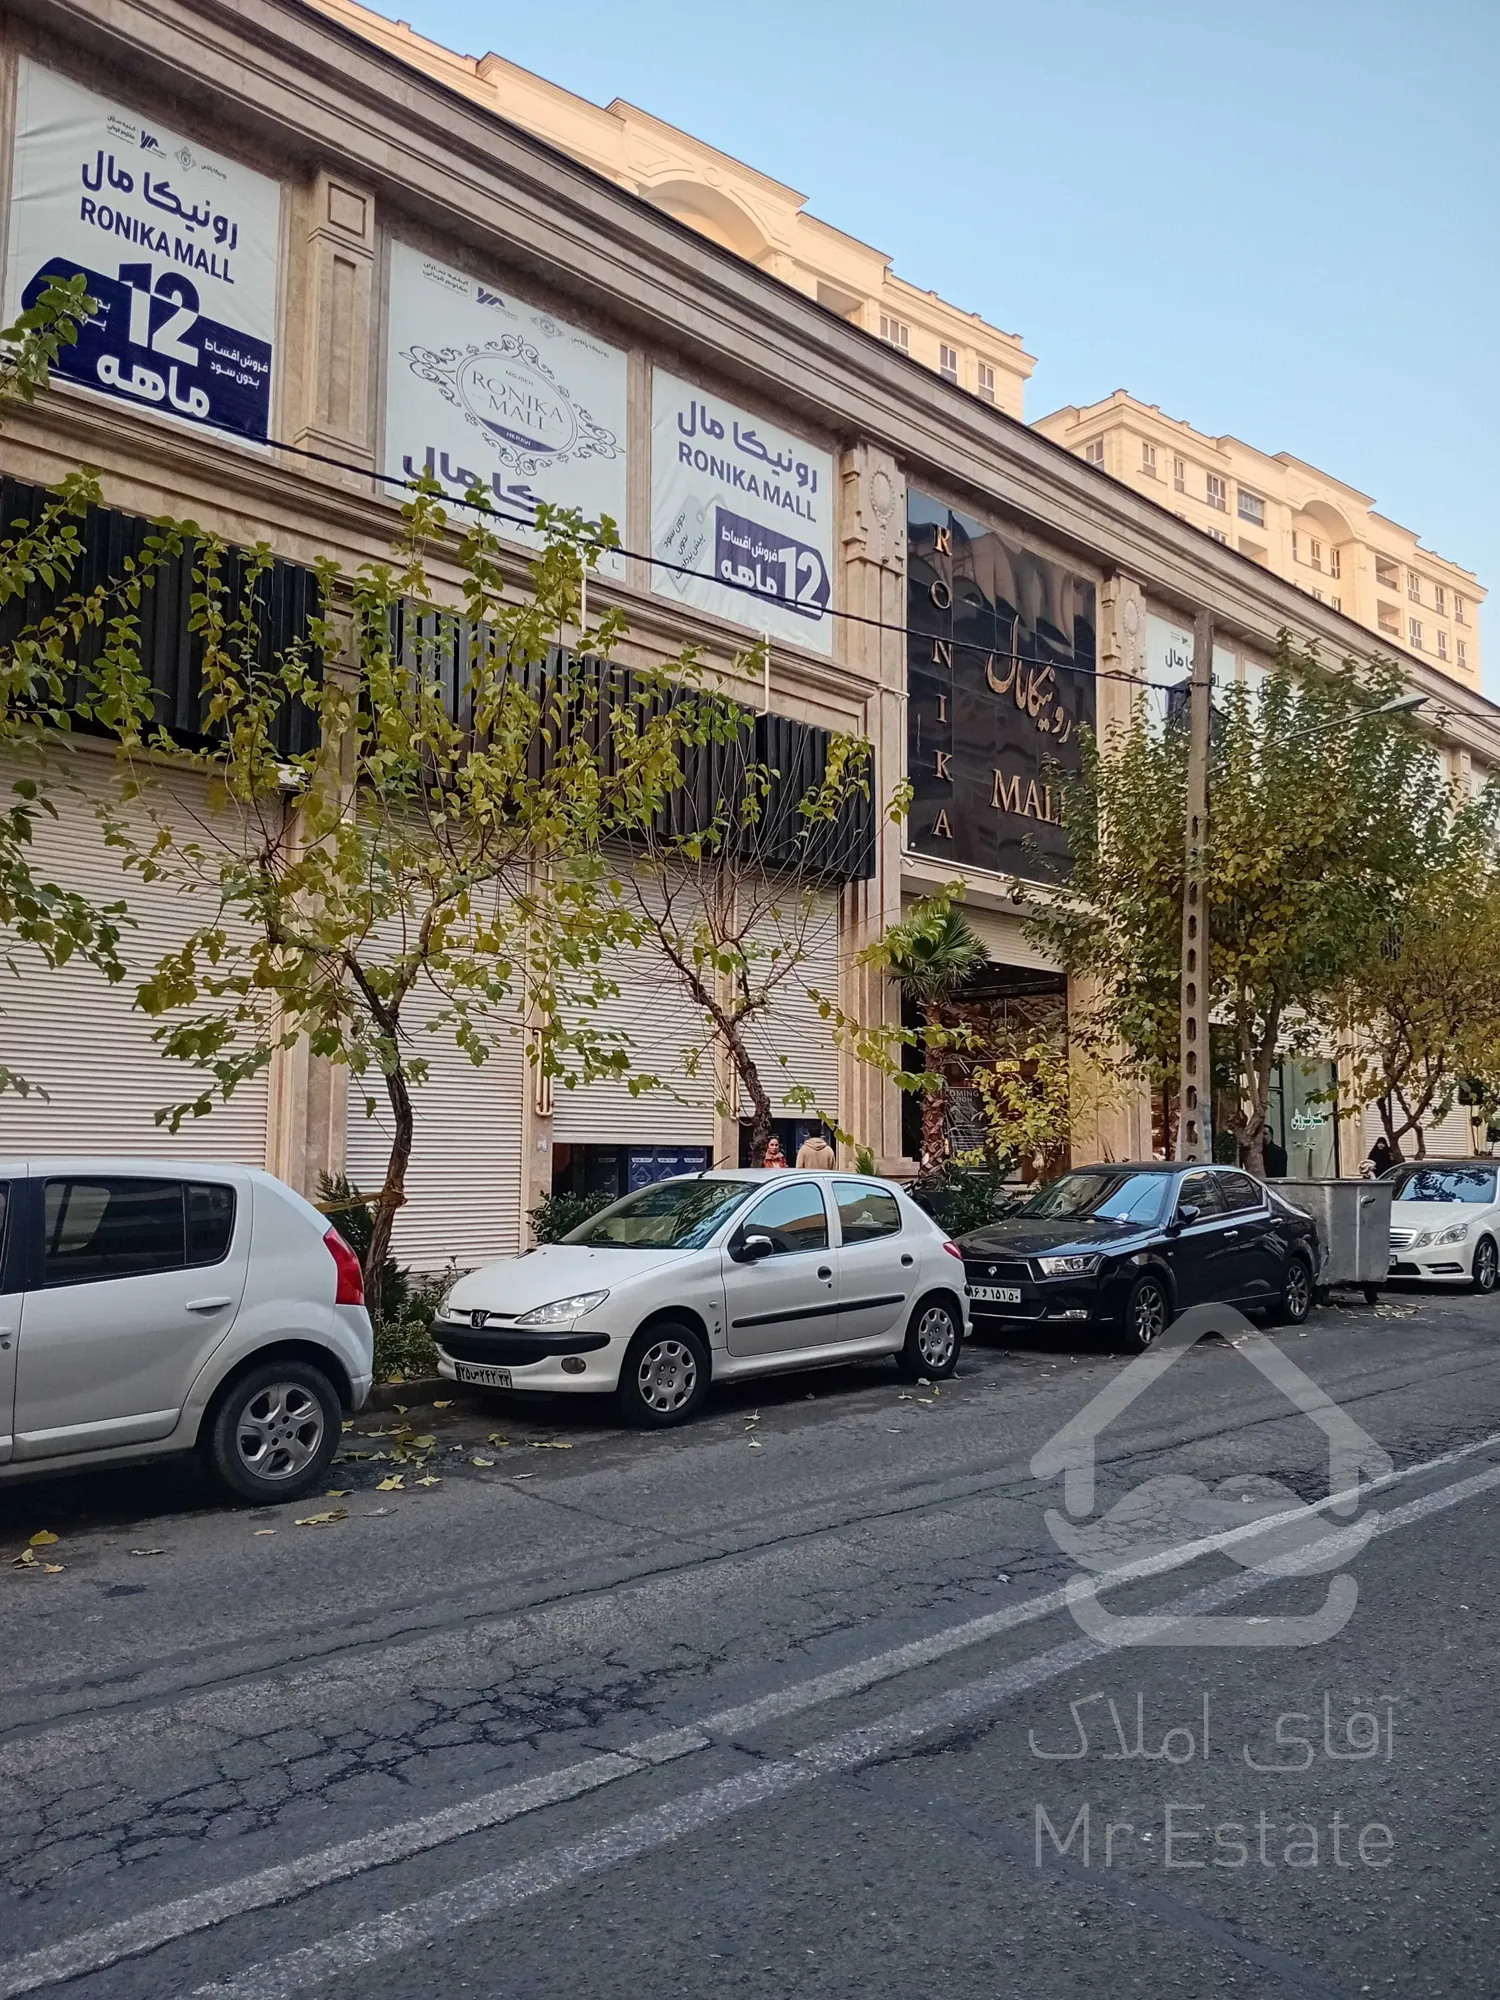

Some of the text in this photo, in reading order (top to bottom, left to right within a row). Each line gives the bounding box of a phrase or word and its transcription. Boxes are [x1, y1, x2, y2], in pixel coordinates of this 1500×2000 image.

[82, 150, 238, 251] رونیکا مال
[81, 196, 235, 284] RONIKA MALL
[118, 262, 200, 366] 12
[205, 338, 269, 373] فروش اقساط
[211, 361, 260, 389] بدون سود
[505, 369, 534, 387] MOJDEH
[96, 353, 210, 418] ماهه
[472, 370, 563, 423] RONIKA
[489, 394, 550, 433] MALL
[402, 446, 483, 490] مال
[678, 401, 818, 494] رونیکا مال
[678, 441, 817, 523] RONIKA MALL
[721, 526, 778, 562] فروش اقساط
[720, 559, 778, 596] ماهه
[779, 545, 823, 617] 12
[929, 522, 953, 840] RONIKA
[1165, 648, 1184, 668] مال
